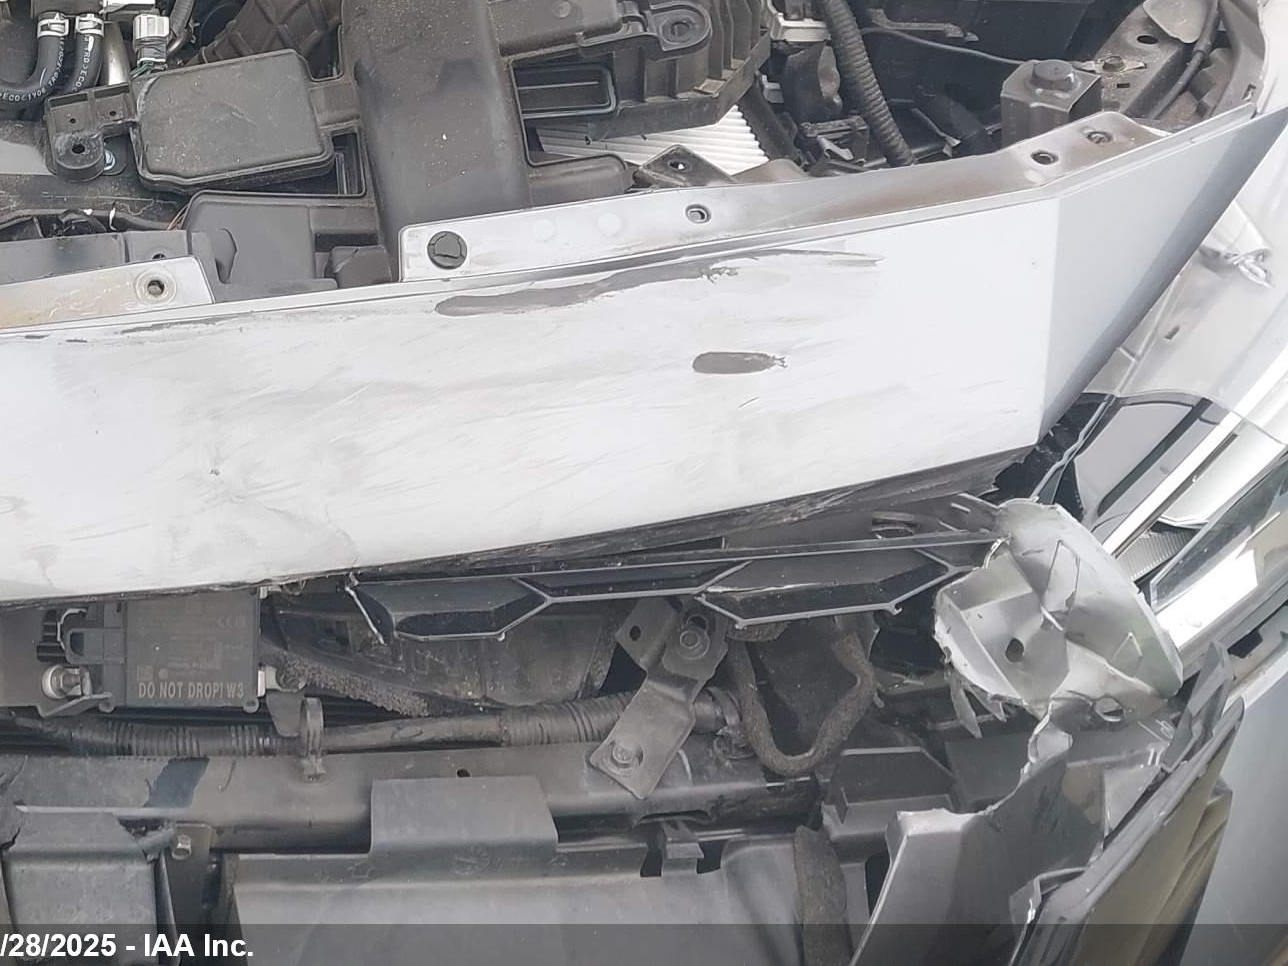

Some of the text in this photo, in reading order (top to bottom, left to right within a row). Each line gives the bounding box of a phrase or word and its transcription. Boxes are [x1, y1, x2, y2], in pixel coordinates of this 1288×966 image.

[138, 682, 155, 698] DO
[159, 682, 183, 698] NOT
[188, 682, 223, 698] DROP!
